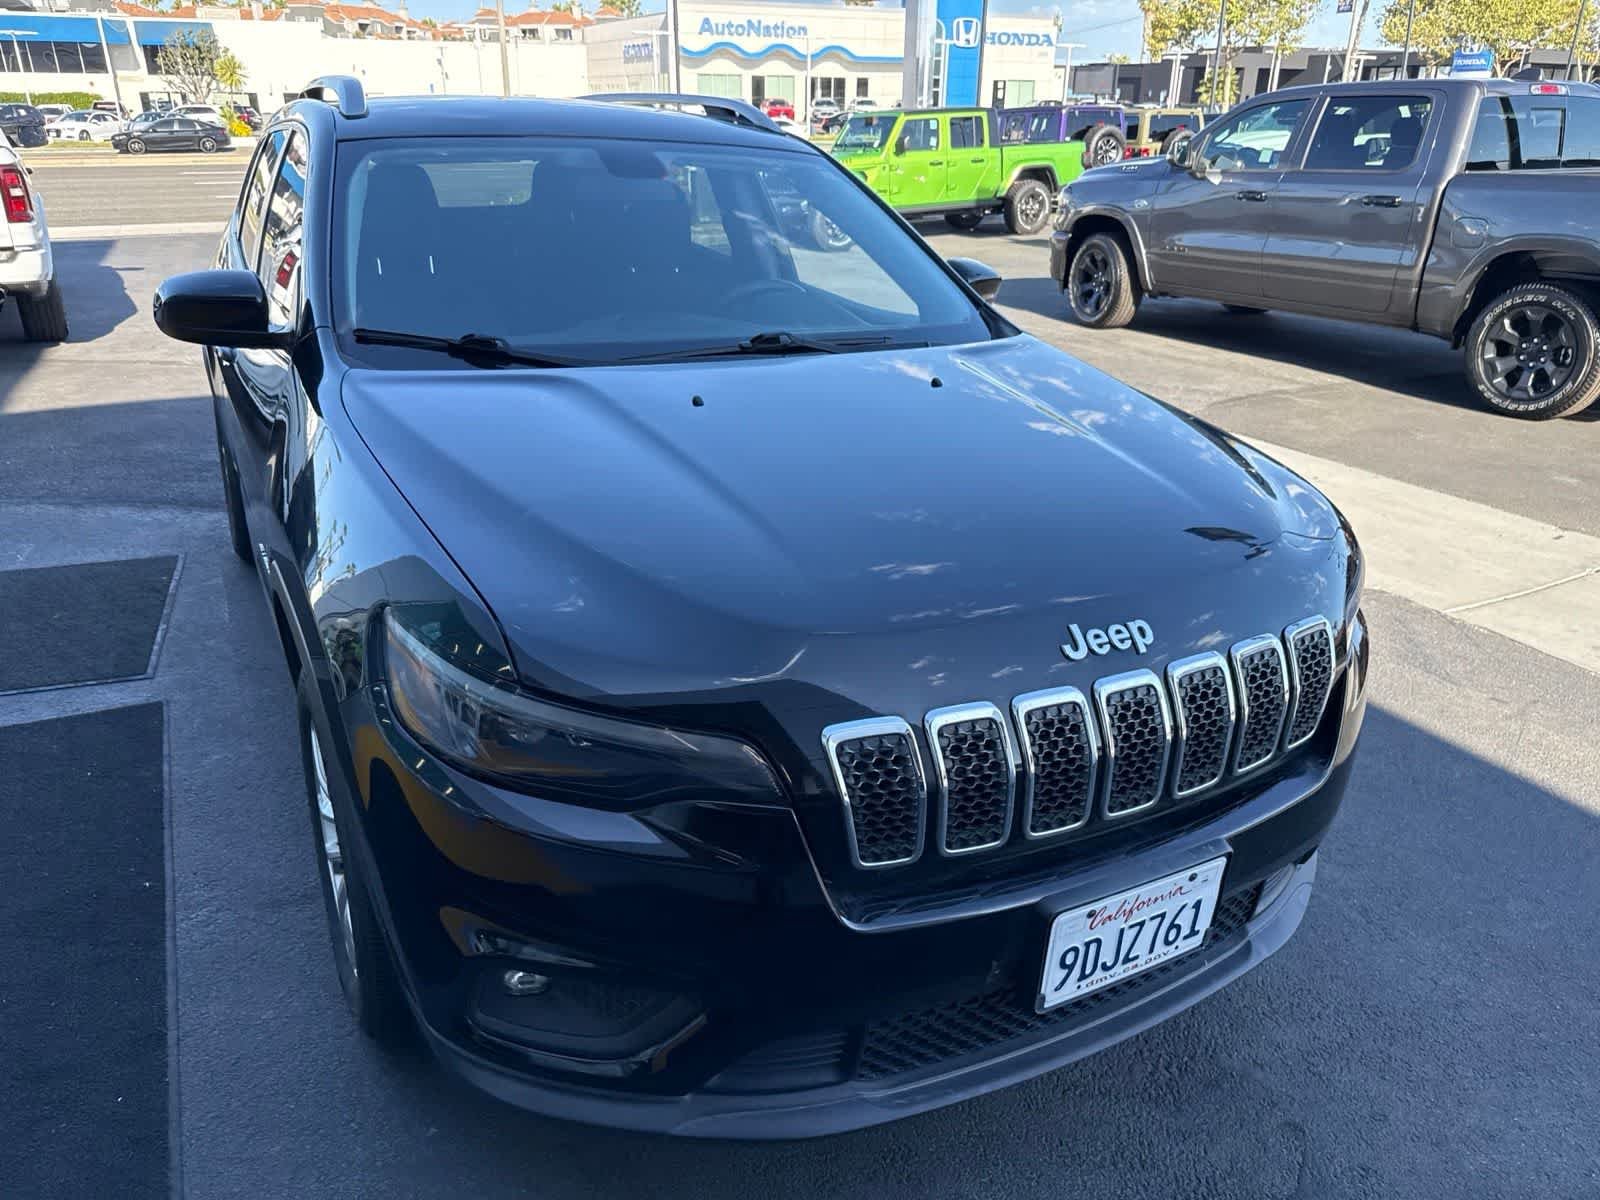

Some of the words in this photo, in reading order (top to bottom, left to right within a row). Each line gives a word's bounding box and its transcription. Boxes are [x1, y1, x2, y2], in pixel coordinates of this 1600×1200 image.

[698, 17, 808, 38] AutoNation
[985, 31, 1055, 47] HONDA
[1060, 619, 1154, 660] Jeep
[1088, 884, 1192, 930] California
[1054, 898, 1203, 992] 9DJZ761
